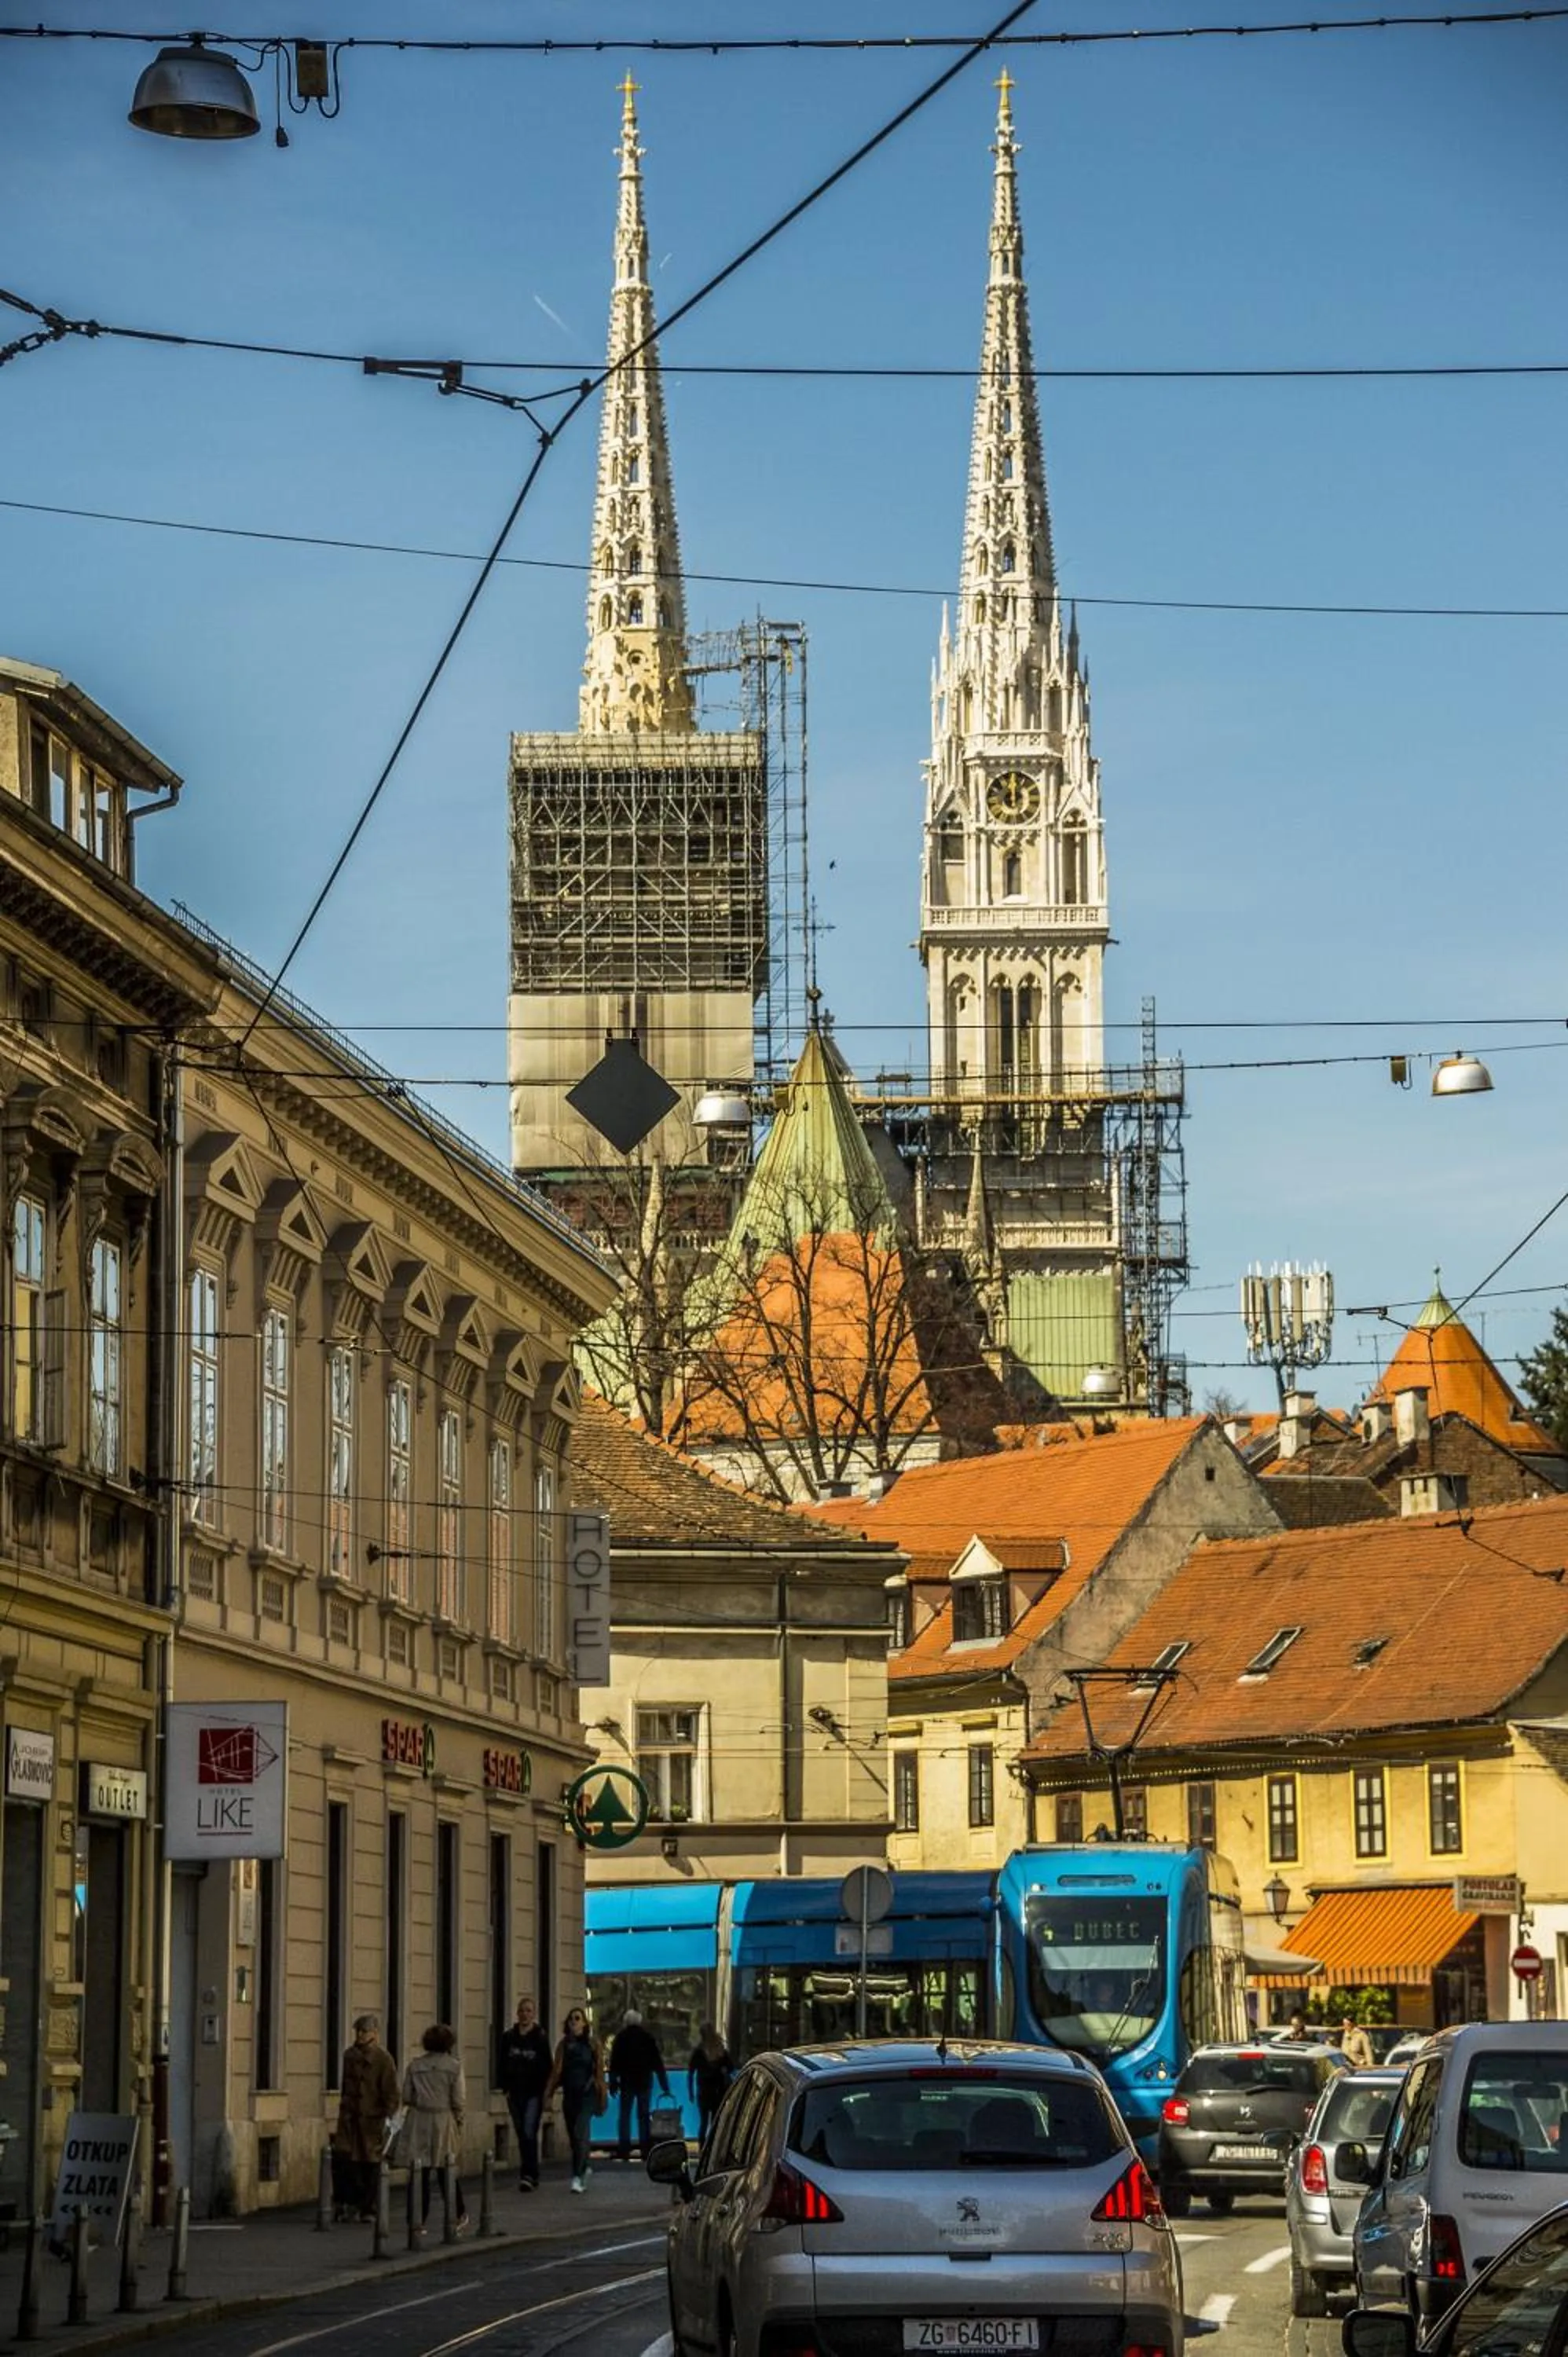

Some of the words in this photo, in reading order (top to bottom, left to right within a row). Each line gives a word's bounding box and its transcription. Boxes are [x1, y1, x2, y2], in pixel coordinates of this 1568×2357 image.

[573, 1516, 603, 1681] HOTEL
[382, 1719, 423, 1767] SPAR
[483, 1747, 521, 1792] SPAR
[98, 1784, 138, 1813] OUTLET
[196, 1797, 255, 1828] LIKE
[1073, 1923, 1140, 1940] DUBEC
[67, 2139, 127, 2162] OTKUP
[63, 2174, 117, 2197] ZLATA
[918, 2323, 943, 2345] ZG
